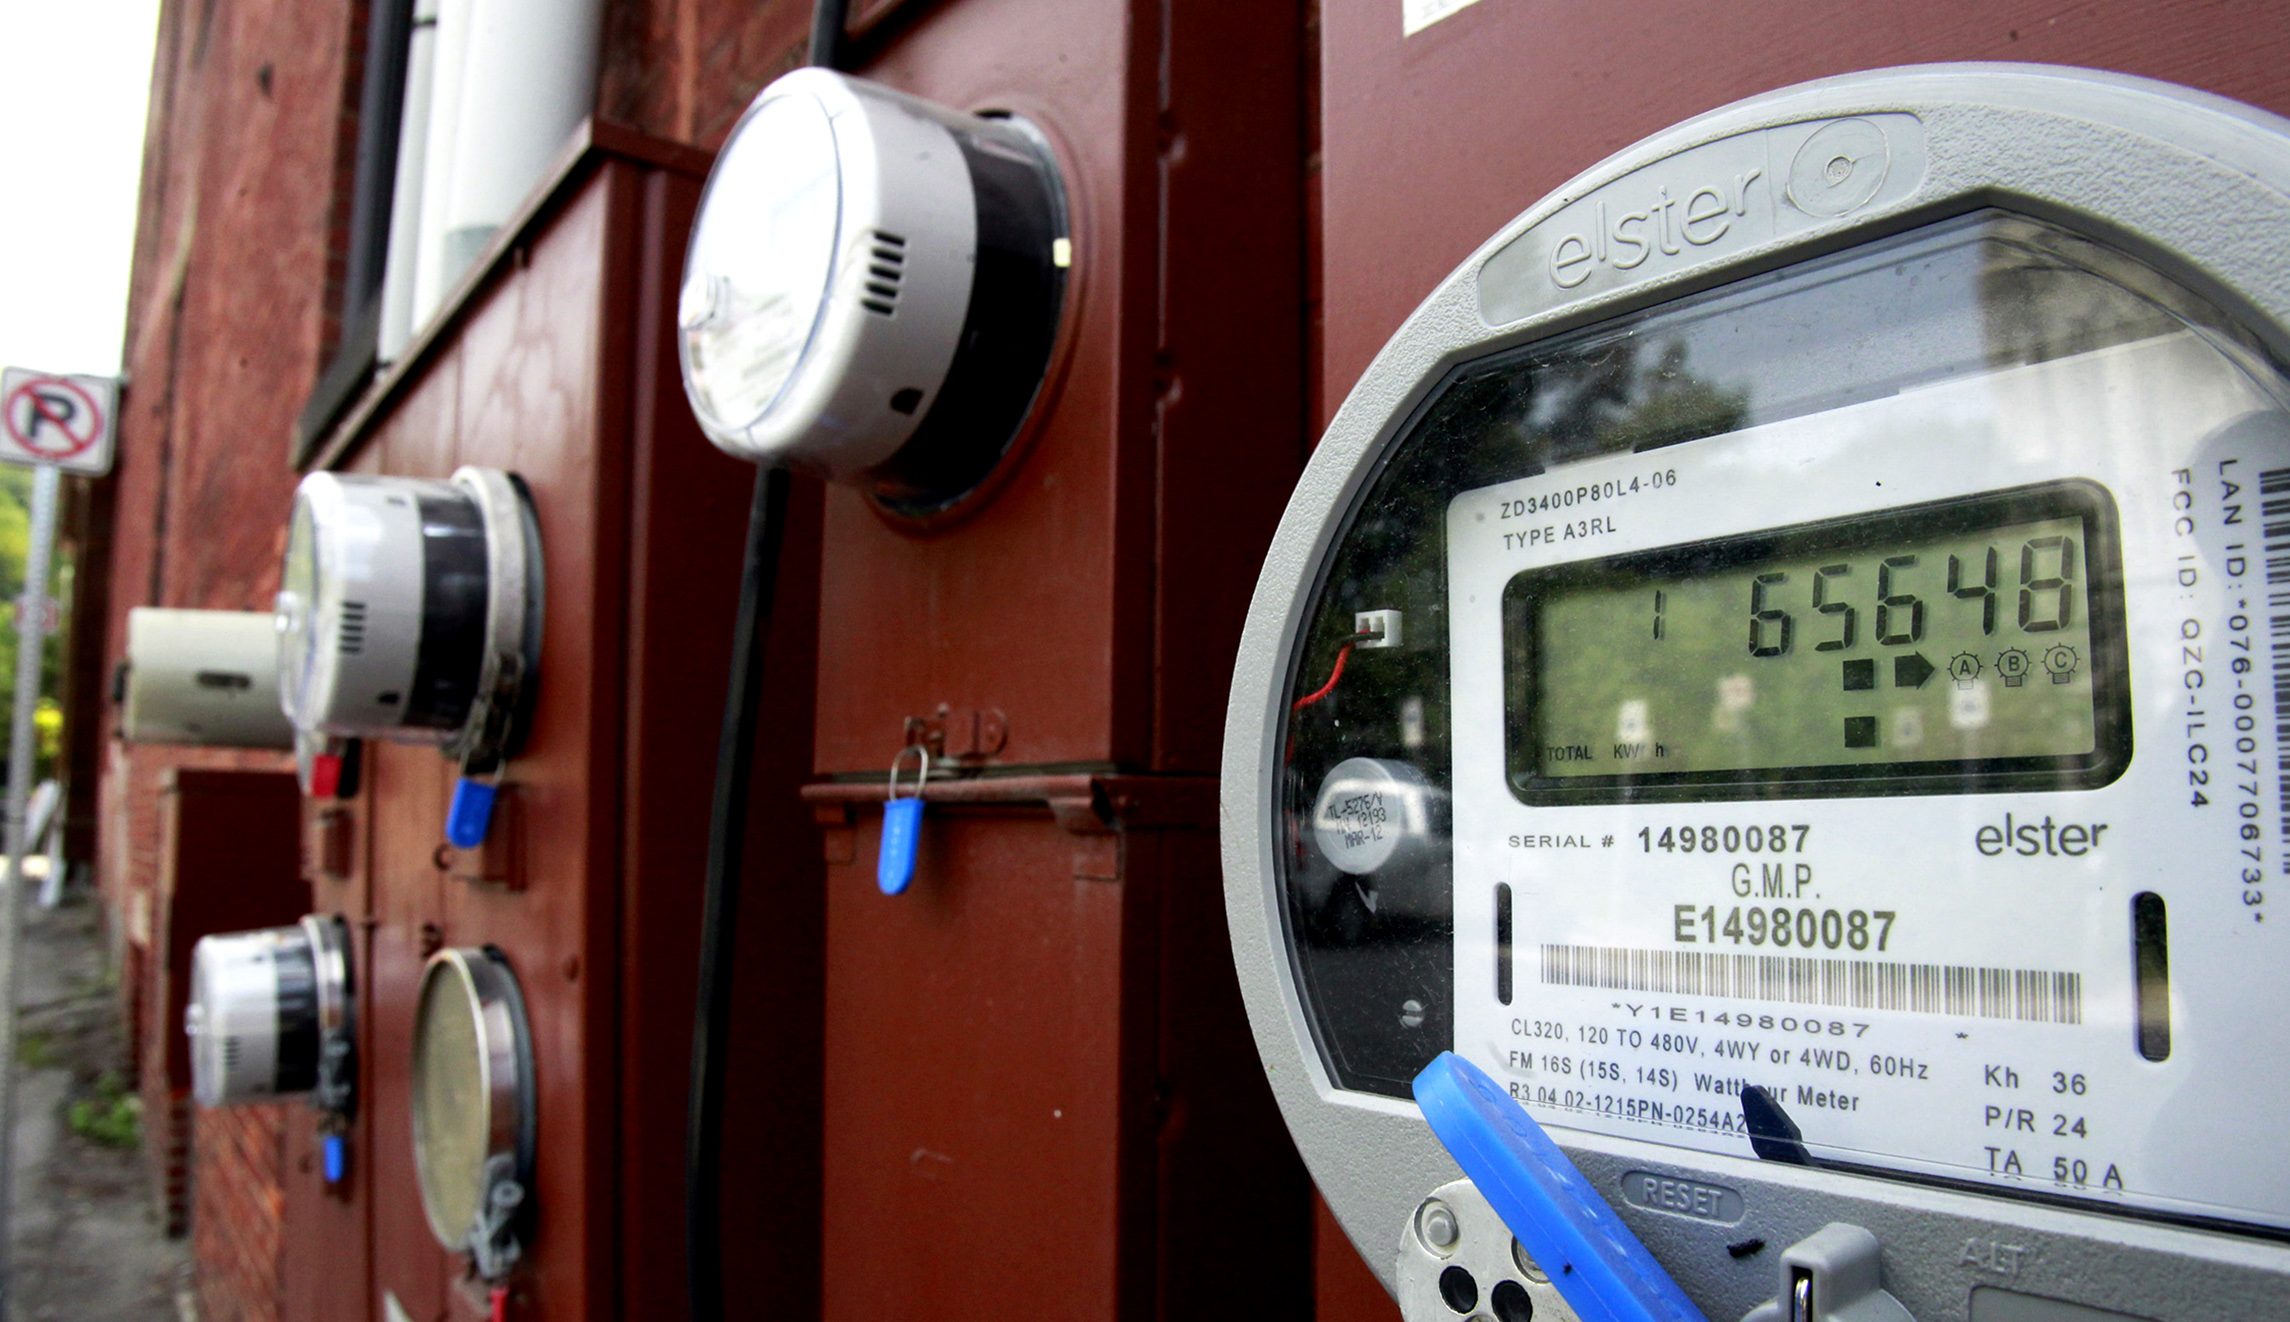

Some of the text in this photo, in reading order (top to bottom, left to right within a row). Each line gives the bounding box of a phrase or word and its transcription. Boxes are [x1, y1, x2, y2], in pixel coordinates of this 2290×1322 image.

[1548, 167, 1763, 290] elster
[1500, 468, 1677, 519] ZD3400P80L4-06
[2171, 467, 2195, 537] FCC
[2218, 459, 2243, 526] LAN
[1503, 516, 1617, 551] TYPE A3RL
[1747, 534, 2074, 657] 65648
[2180, 618, 2210, 808] QZC-ILC24
[1546, 745, 1593, 761] TOTAL
[1508, 824, 1812, 854] SERIAL # 14980087
[1975, 811, 2109, 857] elster
[1731, 862, 1821, 899] G.M.P.
[1673, 904, 1897, 952] E14980087
[1511, 1018, 1929, 1080] CL320, 120 TO 480V, 4WY or 4WD, 60Hz
[1509, 1050, 1533, 1070] FM
[1541, 1055, 1572, 1075] 16S
[1579, 1059, 1627, 1084] (15S,
[1637, 1066, 1678, 1092] 14S)
[1797, 1085, 1860, 1112] Meter
[1984, 1064, 2087, 1096] Kh 36
[1985, 1105, 2088, 1139] P/R 24
[1983, 1146, 2124, 1190] TA 50 A
[1642, 1176, 1724, 1218] RESET
[1957, 1236, 2026, 1274] ALT
